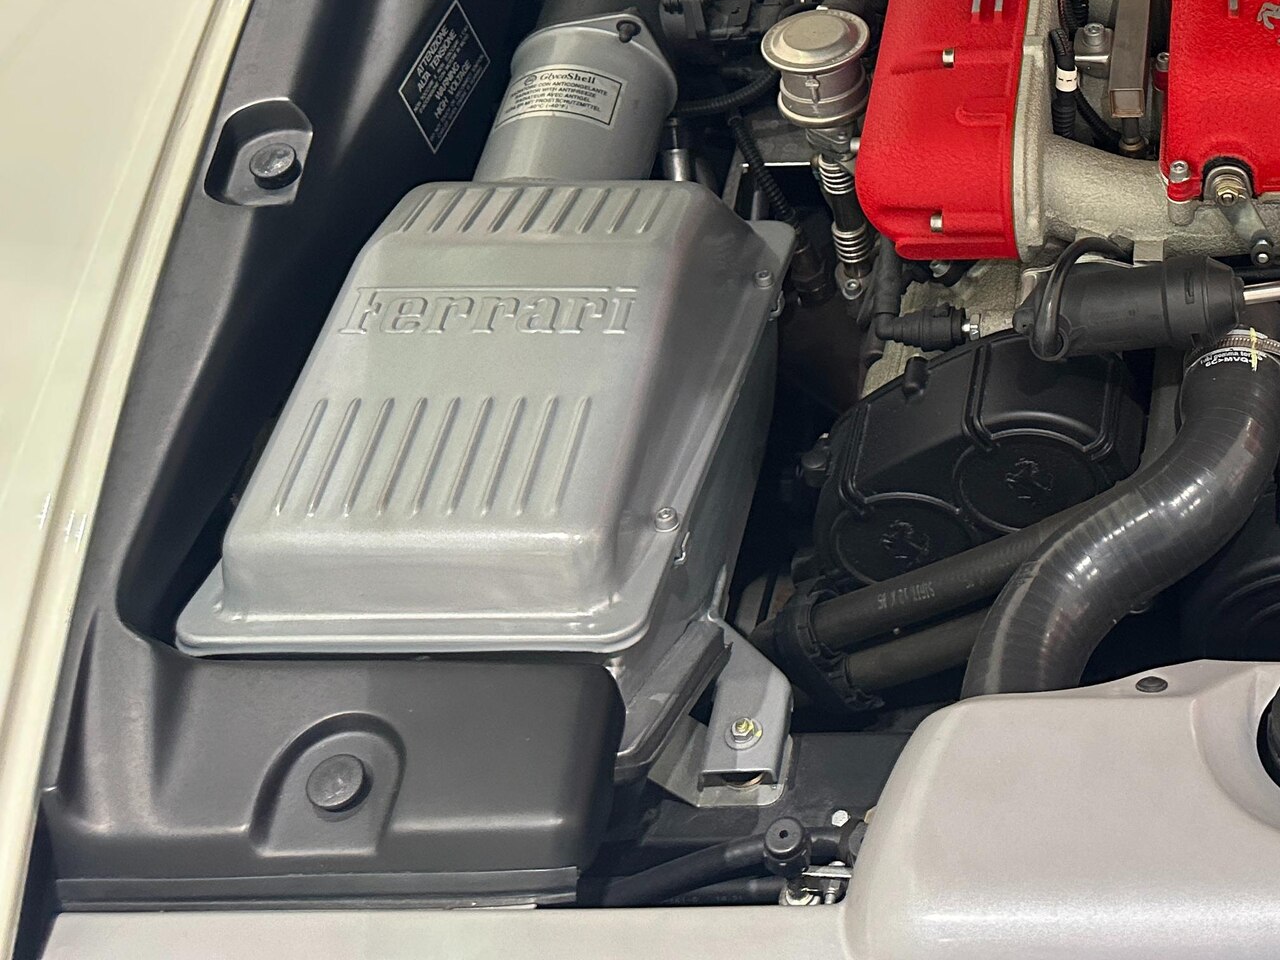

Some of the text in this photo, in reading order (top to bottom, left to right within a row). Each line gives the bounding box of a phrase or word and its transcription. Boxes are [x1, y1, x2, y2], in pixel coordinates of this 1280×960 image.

[416, 24, 449, 77] ATTENZIONE
[417, 28, 457, 93] ALTA TENSIONE
[434, 61, 461, 101] WARNING
[434, 95, 449, 120] HIGH
[448, 58, 472, 95] VOLTAGE
[539, 72, 596, 84] GlycoShell
[338, 285, 640, 335] Ferrari
